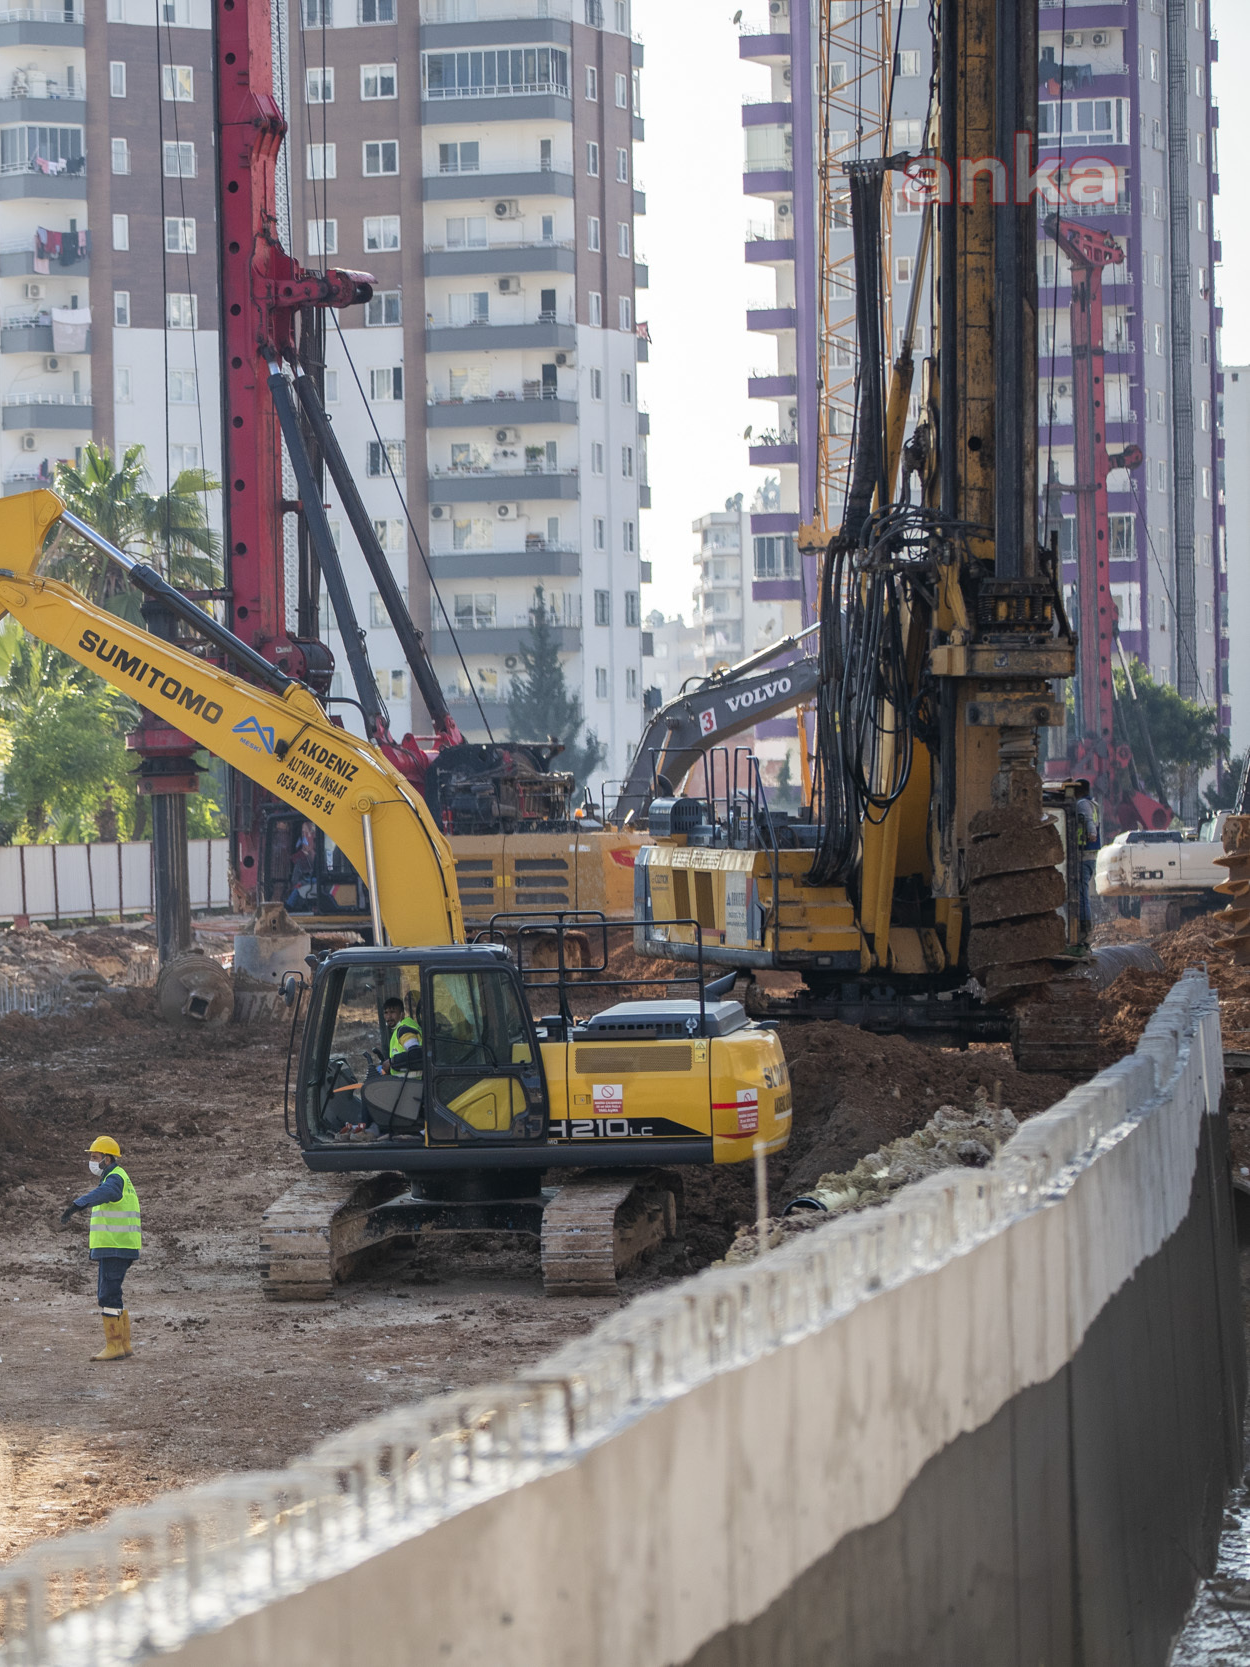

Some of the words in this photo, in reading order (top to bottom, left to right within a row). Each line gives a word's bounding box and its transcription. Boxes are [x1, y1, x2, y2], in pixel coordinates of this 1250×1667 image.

[78, 629, 224, 725] SUMITOMO
[725, 677, 792, 712] VOLVO
[702, 711, 714, 732] 3
[286, 756, 318, 782] ALTYAPI
[313, 772, 324, 785] &
[320, 773, 348, 799] İNŞAAT
[297, 738, 360, 782] AKDENİZ
[276, 773, 299, 793] 0534
[296, 784, 313, 802] 591
[311, 793, 325, 809] 95
[322, 800, 336, 815] 91
